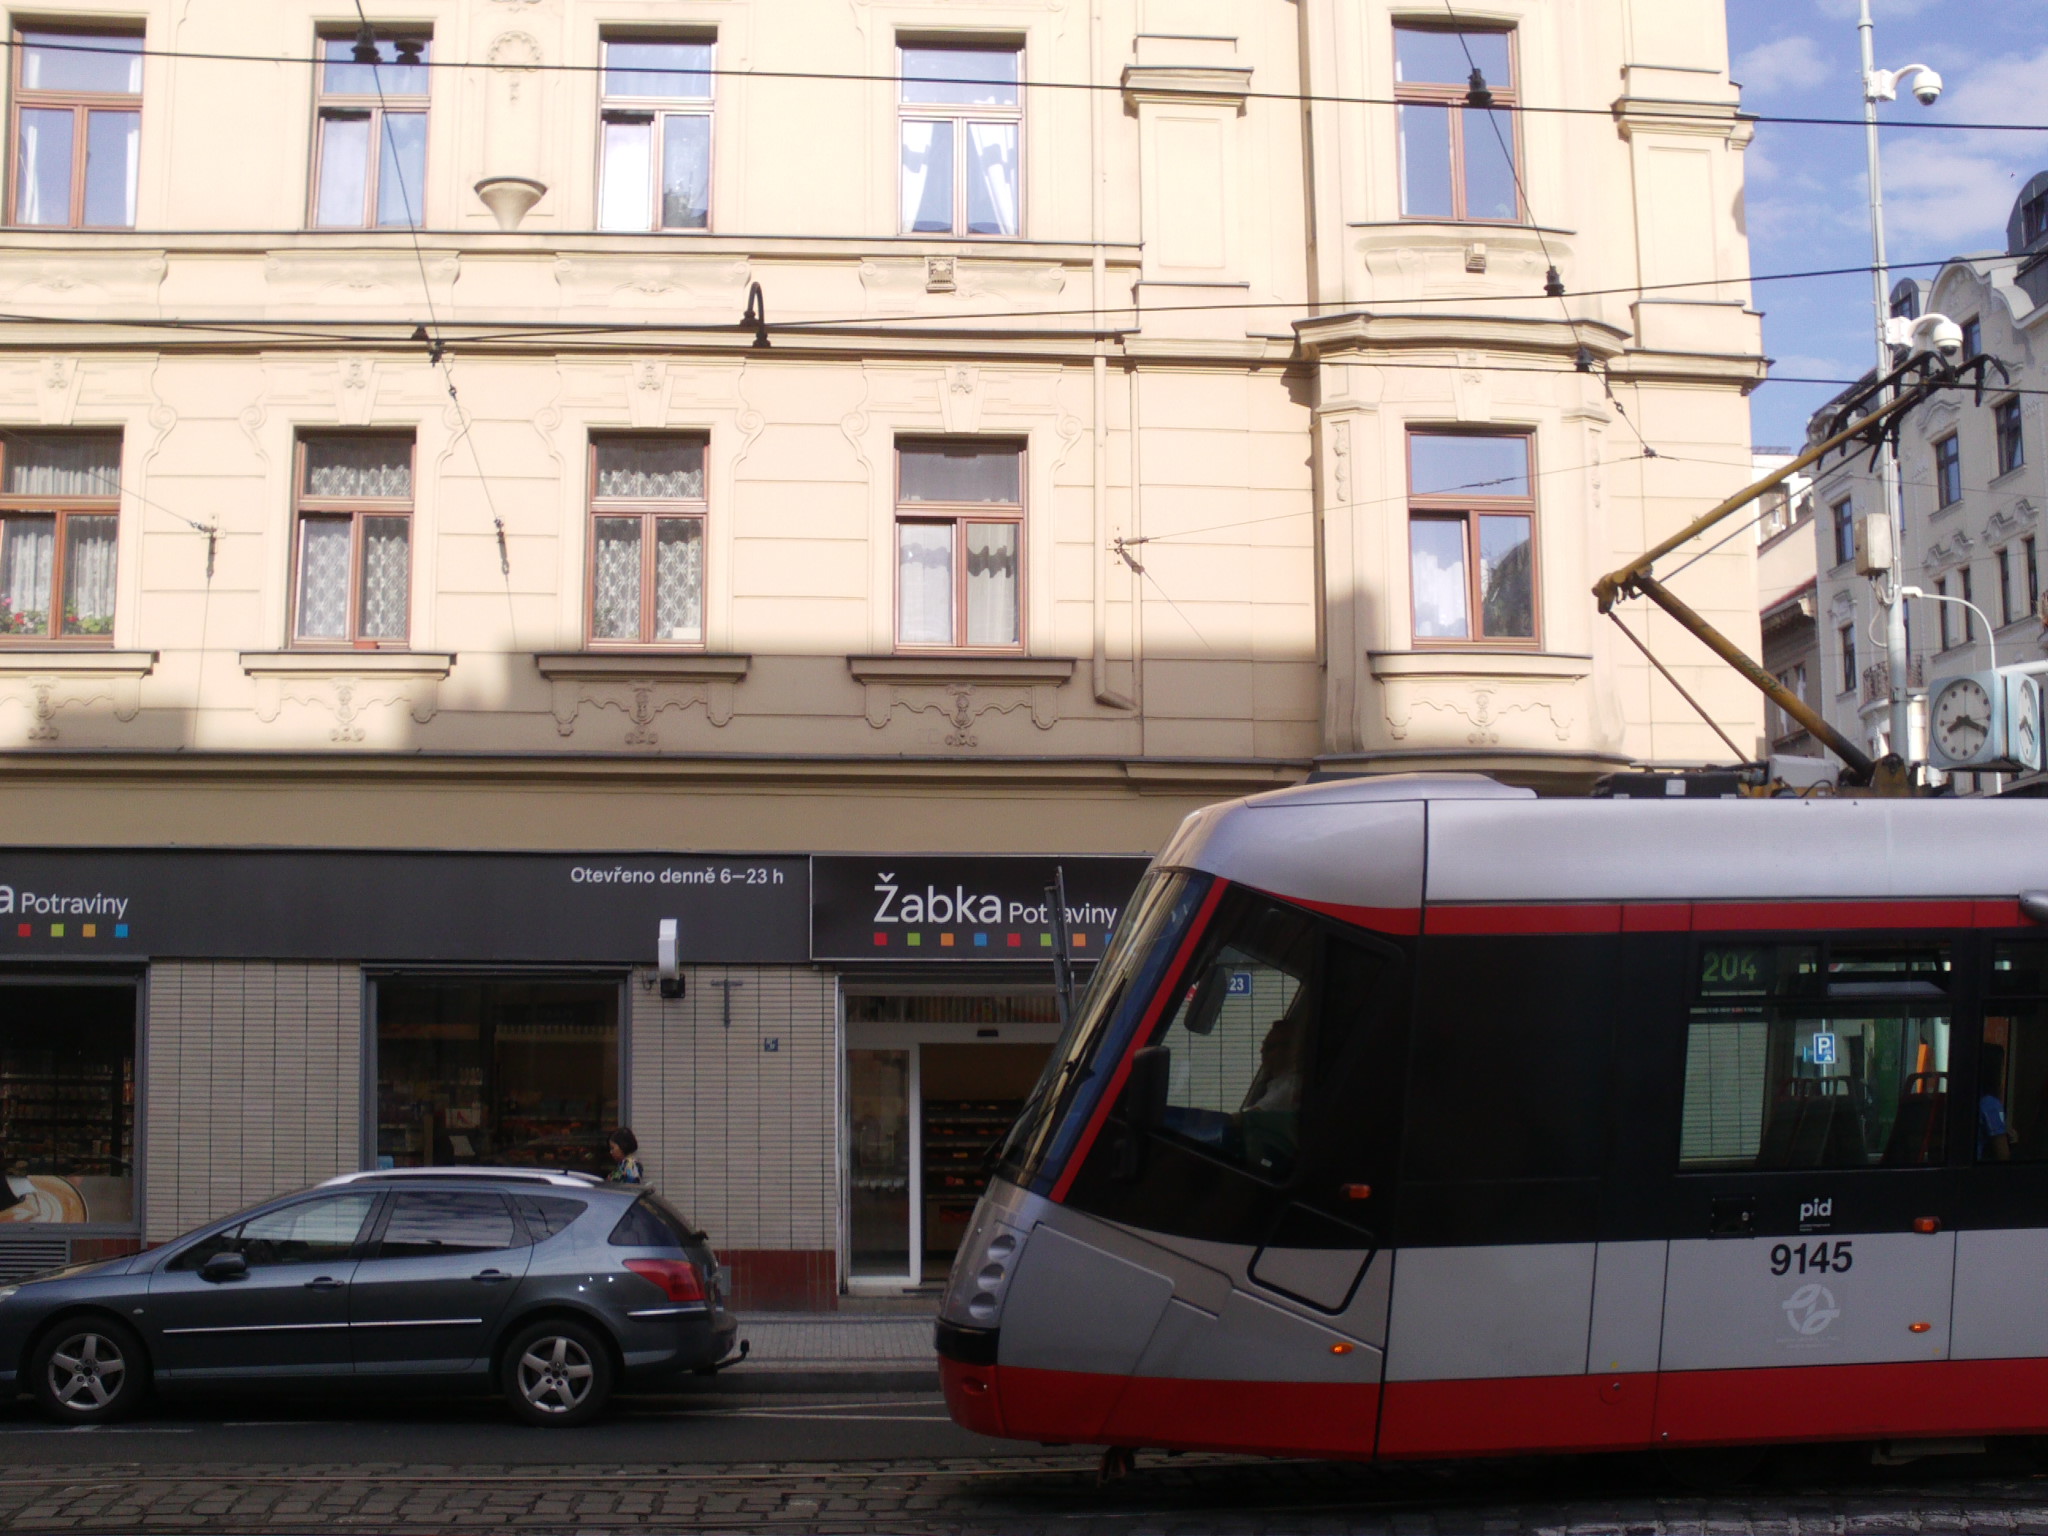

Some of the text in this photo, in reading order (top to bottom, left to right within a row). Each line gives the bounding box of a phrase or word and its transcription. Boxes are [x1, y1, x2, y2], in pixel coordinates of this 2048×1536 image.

[570, 866, 655, 883] Otevřeno
[659, 866, 716, 884] denně
[773, 868, 784, 884] h
[21, 891, 129, 920] Potraviny
[873, 872, 1118, 930] Žabka Potaviny
[1702, 951, 1758, 982] 204
[1818, 1037, 1830, 1055] P
[1800, 1197, 1832, 1222] pid
[1770, 1241, 1853, 1276] 9145
